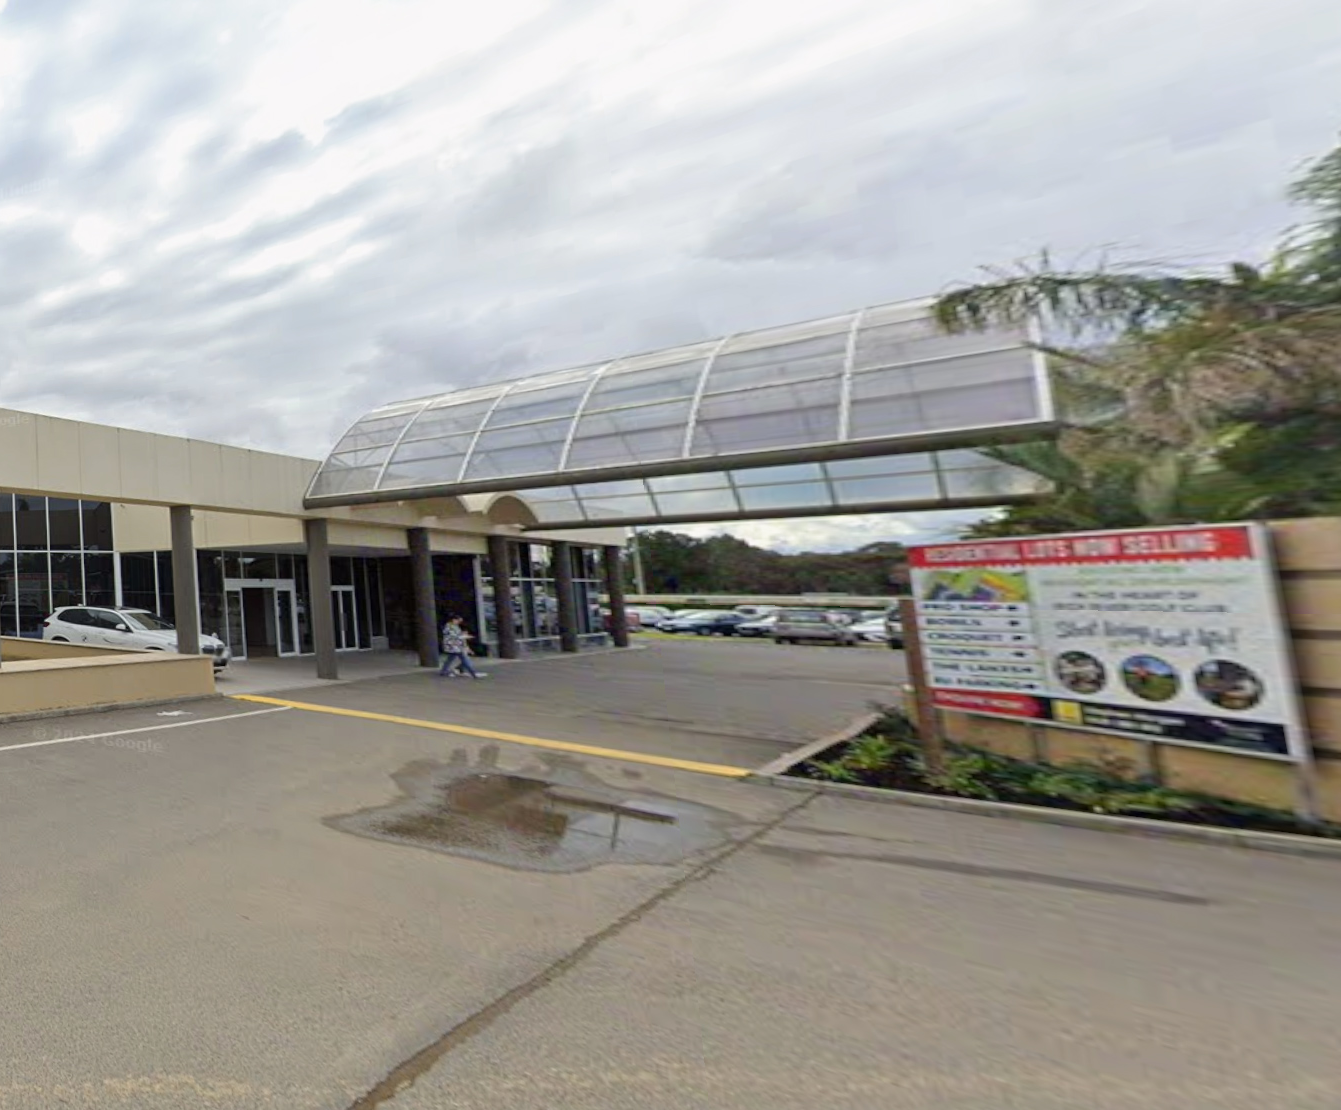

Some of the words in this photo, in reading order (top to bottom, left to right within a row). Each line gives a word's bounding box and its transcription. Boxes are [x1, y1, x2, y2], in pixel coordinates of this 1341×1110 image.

[1022, 538, 1070, 559] LOTS
[1121, 531, 1218, 556] SELLING
[960, 603, 1004, 612] SHOP
